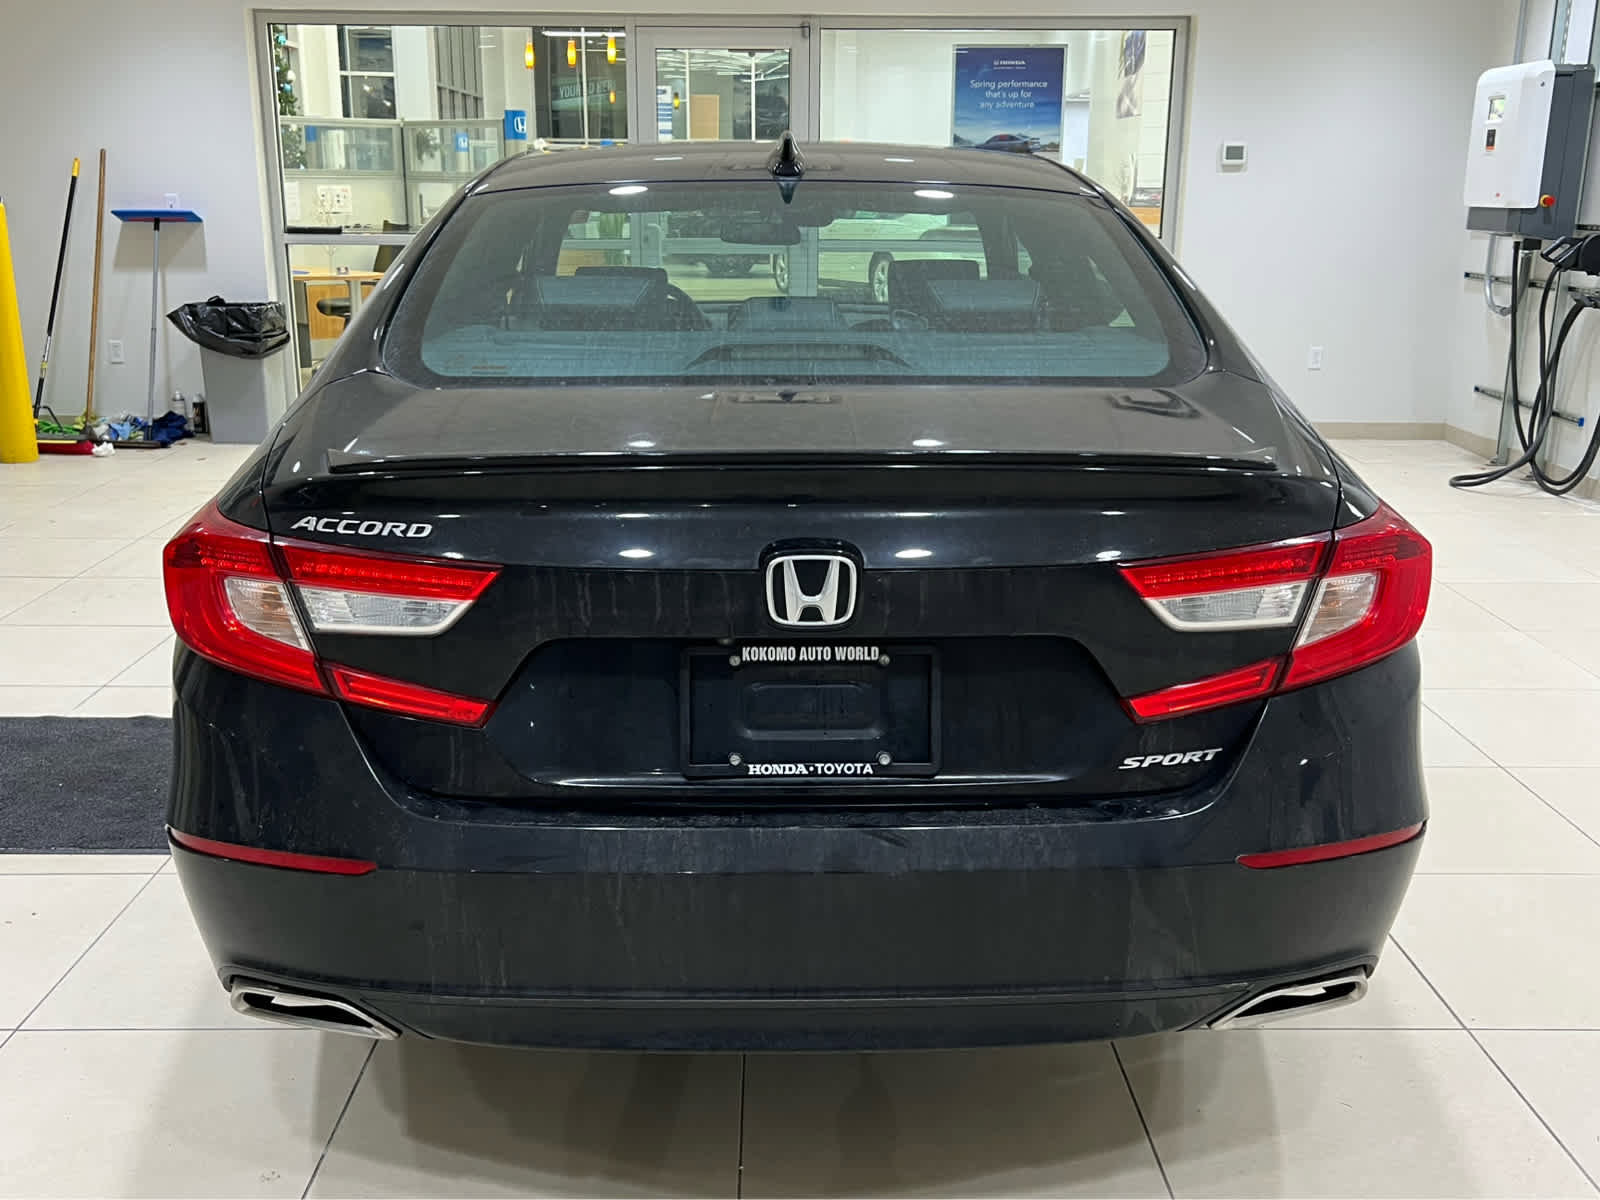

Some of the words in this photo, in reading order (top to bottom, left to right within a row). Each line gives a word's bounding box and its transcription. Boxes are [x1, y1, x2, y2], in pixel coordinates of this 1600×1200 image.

[970, 80, 995, 90] Spring
[997, 80, 1048, 89] performance
[985, 90, 1006, 98] that's
[1020, 90, 1032, 98] for
[979, 102, 993, 110] any
[995, 101, 1035, 109] adventure
[291, 516, 433, 538] ACCORD
[742, 646, 796, 661] KOKOMO
[799, 646, 832, 661] AUTO
[834, 646, 880, 661] WORLD
[1118, 748, 1223, 769] SPORT
